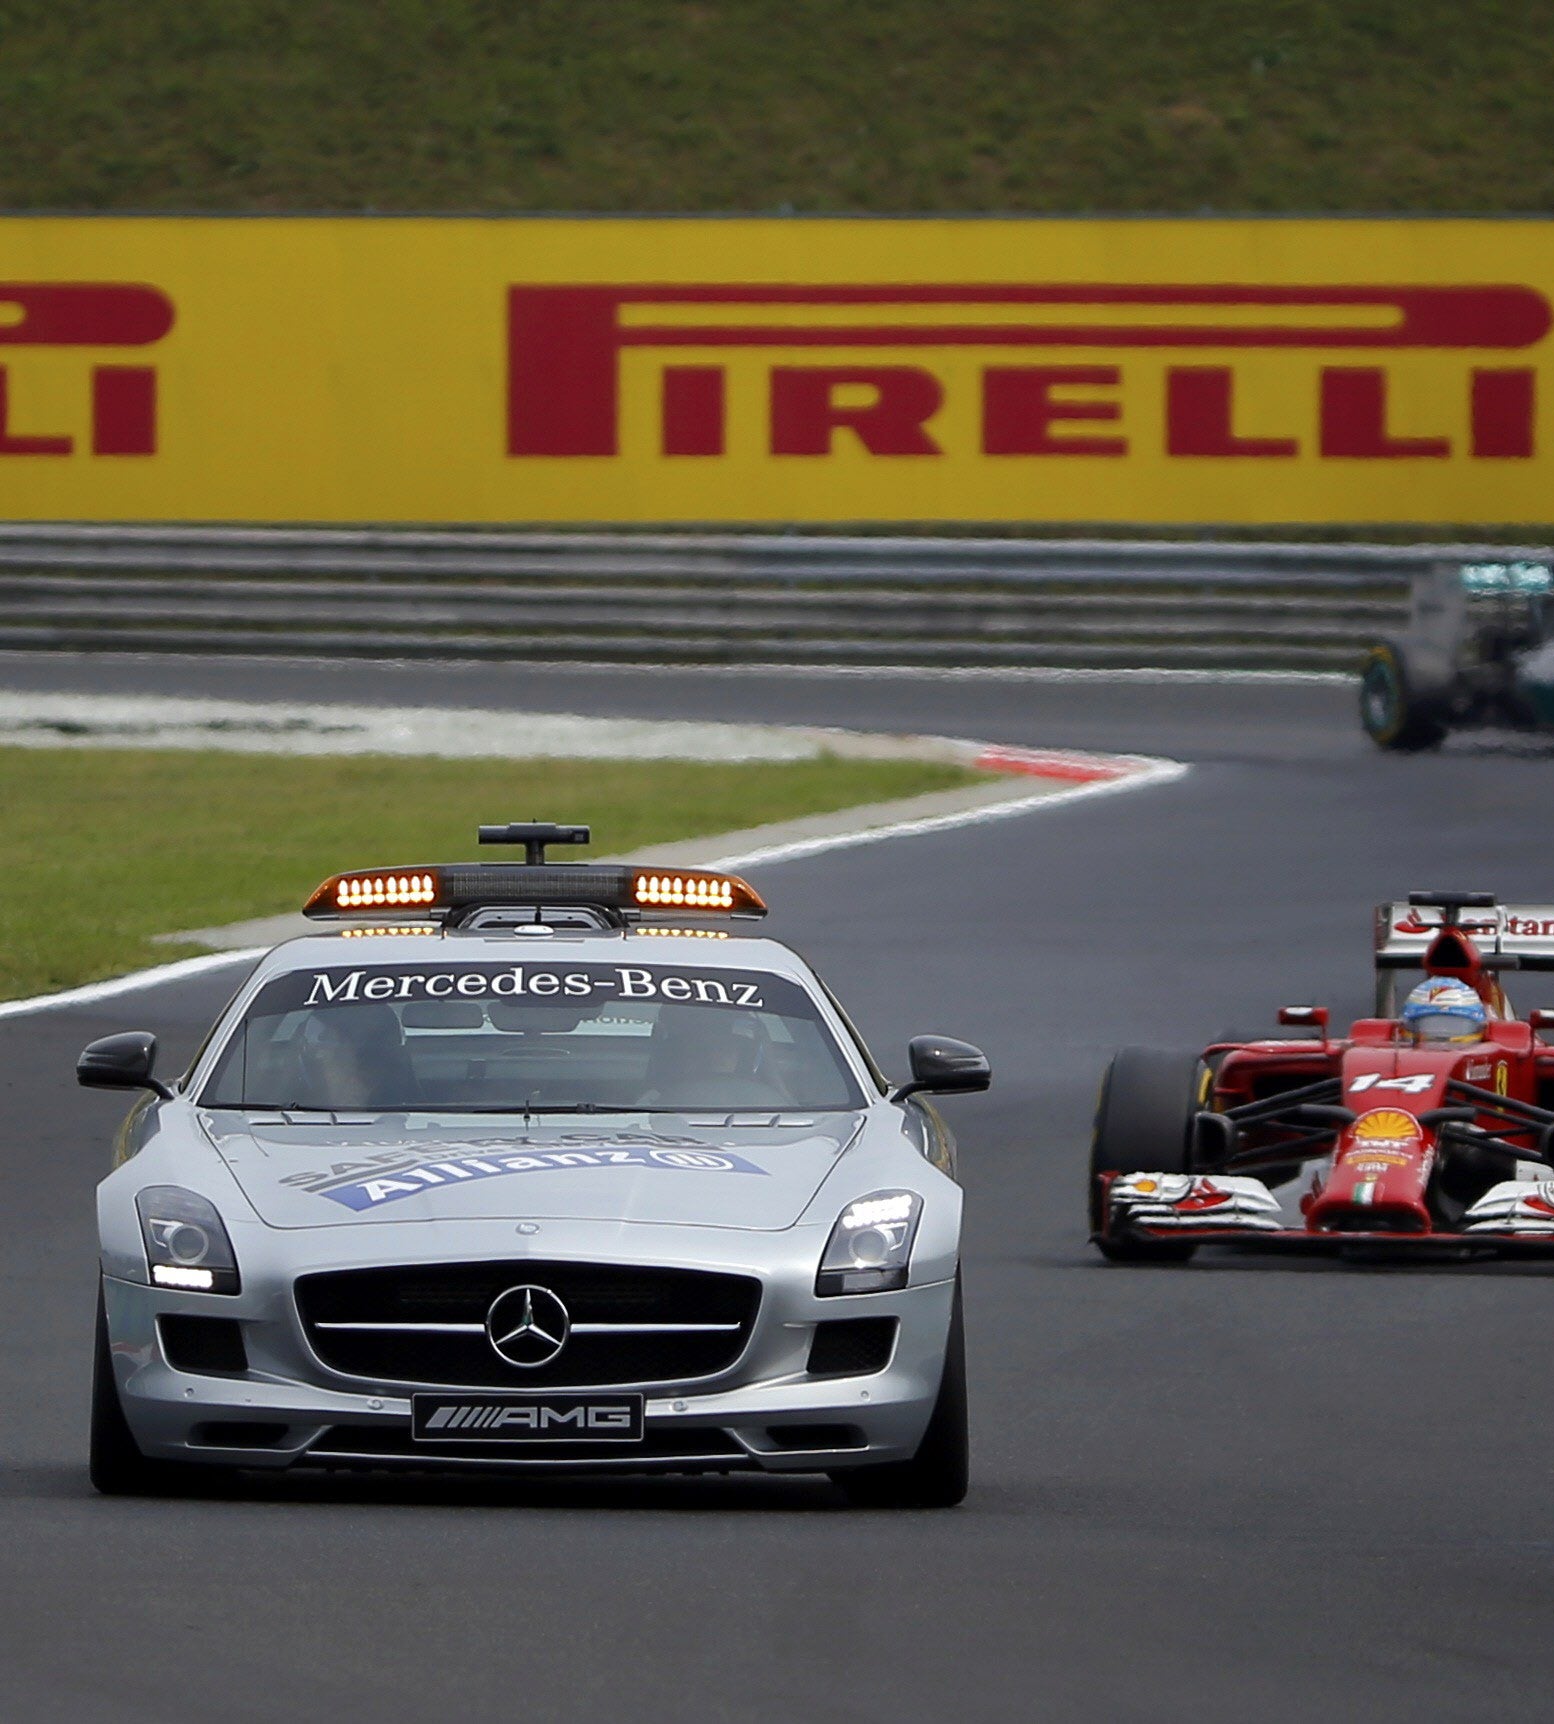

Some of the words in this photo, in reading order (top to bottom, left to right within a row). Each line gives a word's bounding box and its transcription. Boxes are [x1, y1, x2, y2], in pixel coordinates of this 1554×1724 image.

[507, 284, 1553, 458] PIRELLI
[303, 967, 763, 1007] Mercedes-Benz
[1348, 1072, 1436, 1094] 14
[356, 1149, 646, 1202] Allianz
[490, 1406, 631, 1429] AMG
